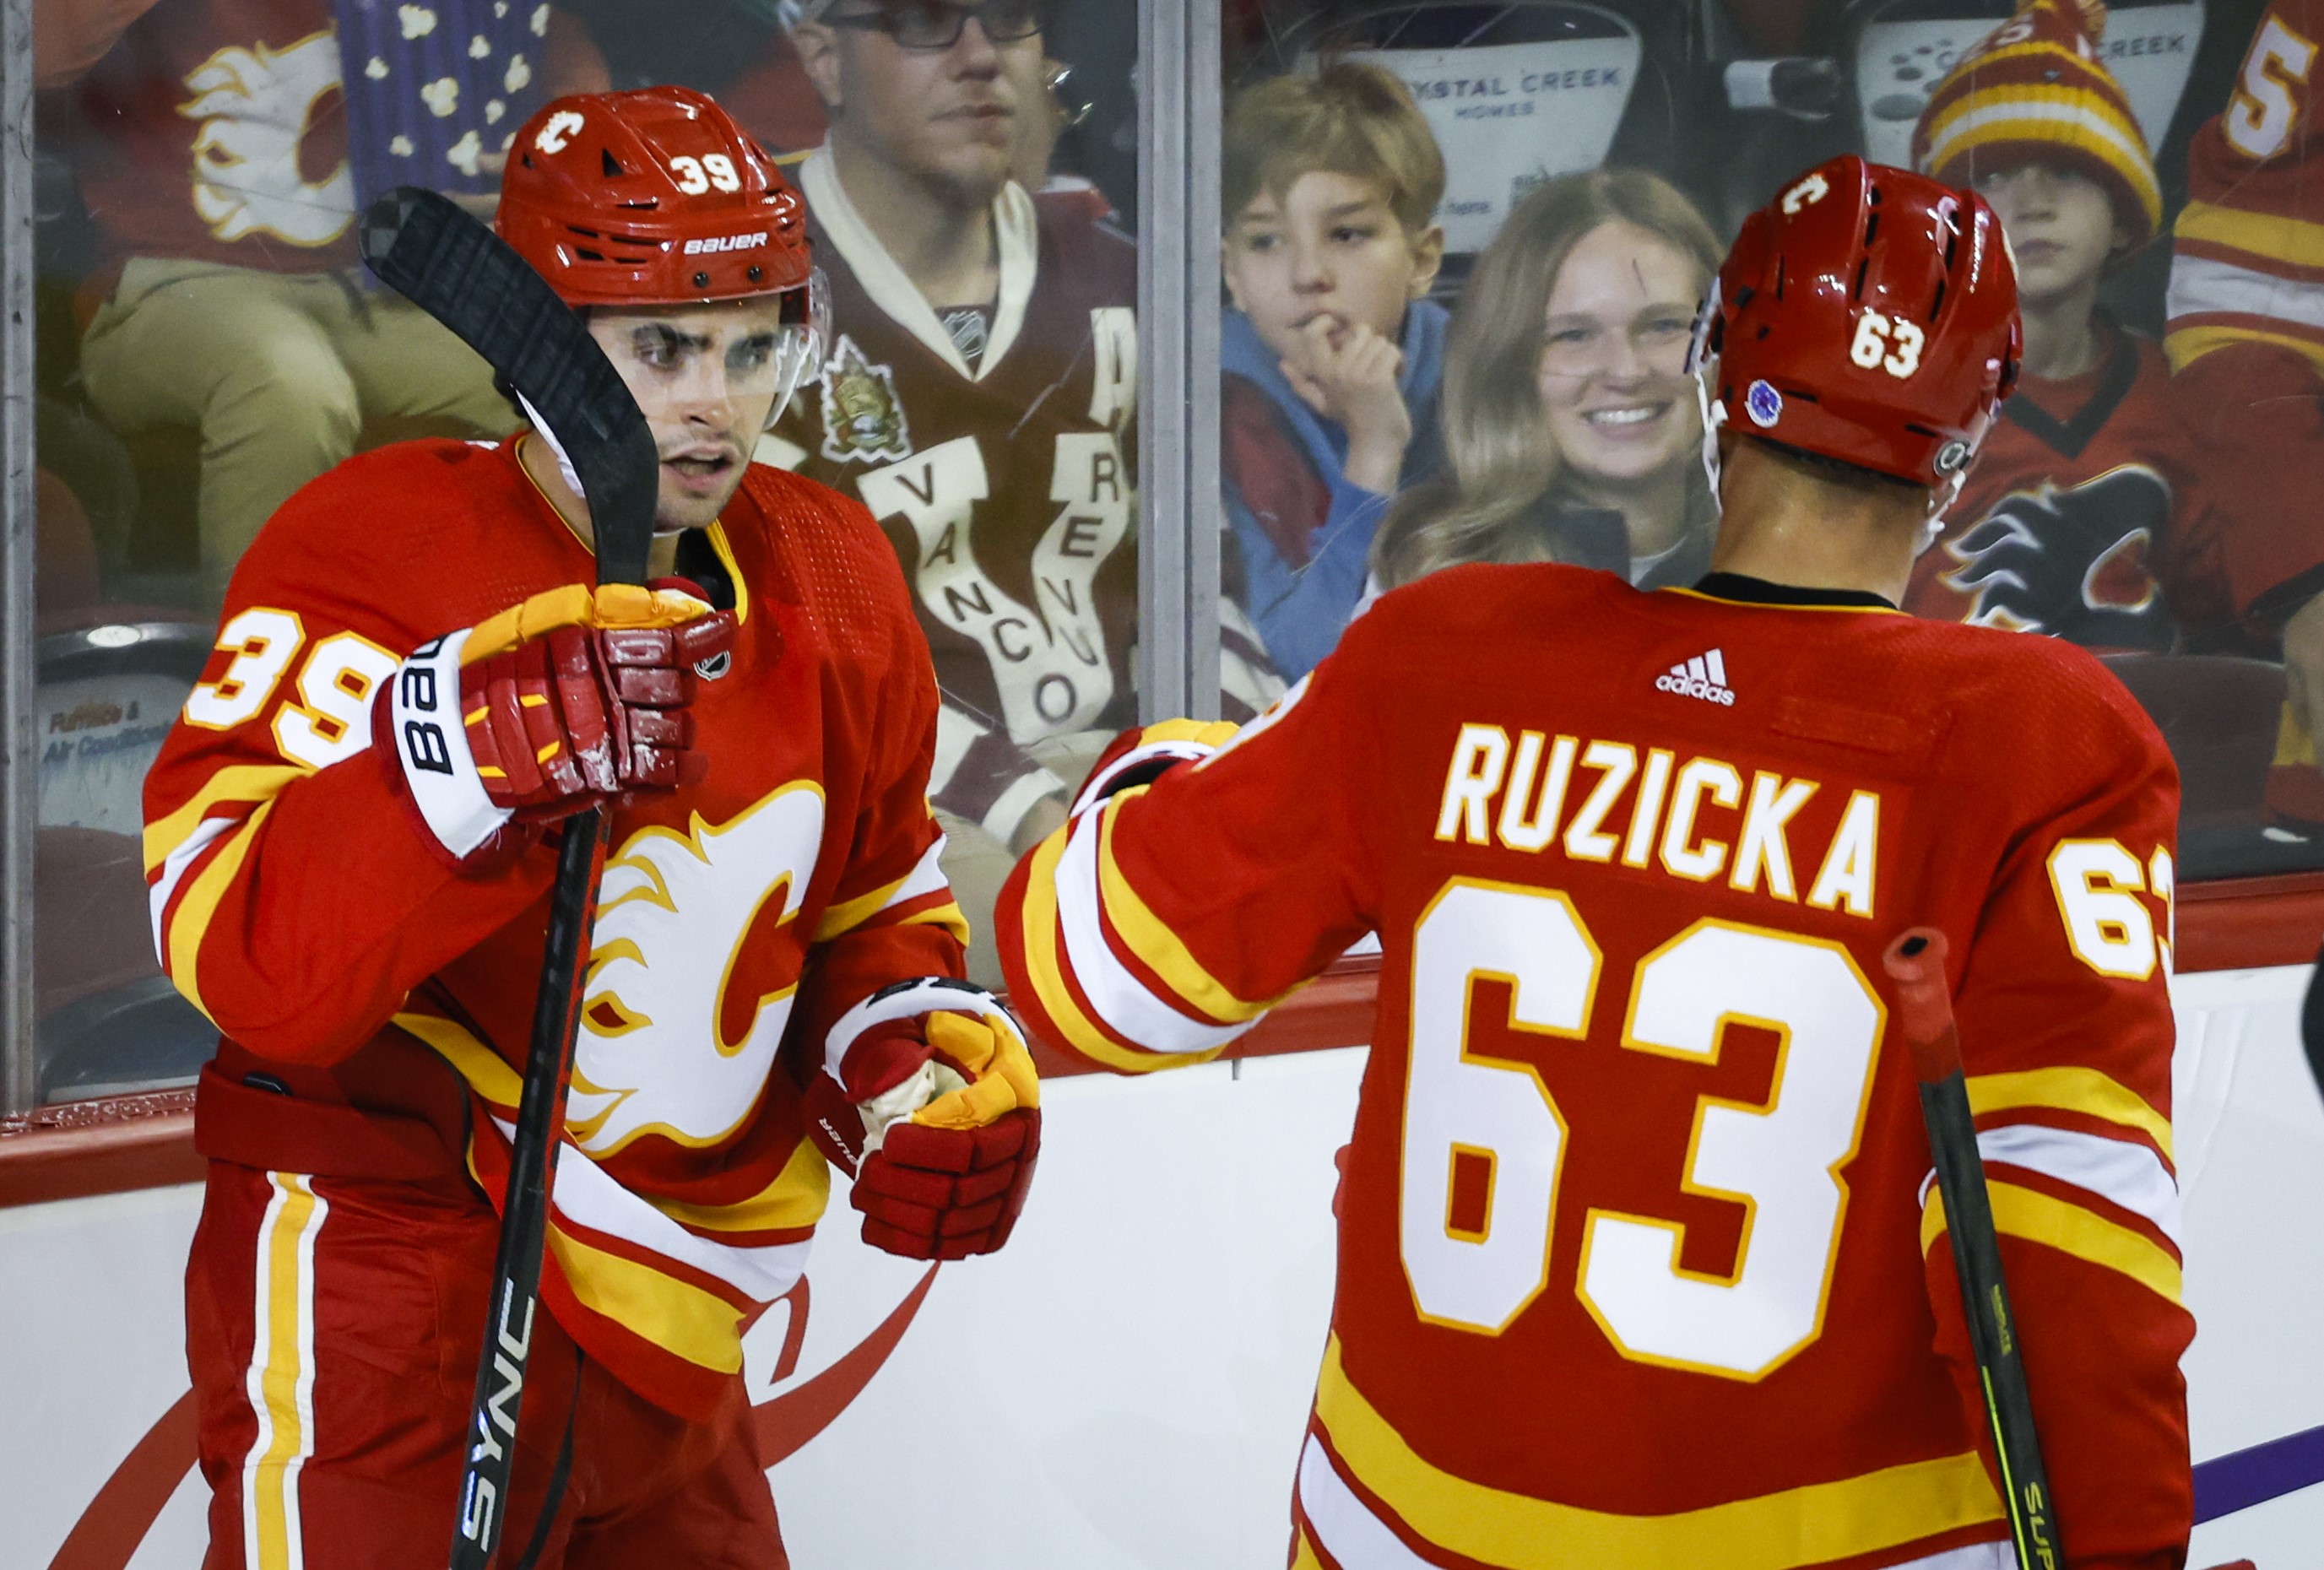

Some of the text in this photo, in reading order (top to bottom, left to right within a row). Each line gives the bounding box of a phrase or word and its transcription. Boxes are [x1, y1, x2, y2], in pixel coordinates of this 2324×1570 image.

[1521, 67, 1620, 95] CREEK
[669, 153, 743, 196] 39
[683, 231, 768, 255] BAUER
[1850, 311, 1926, 379] 63
[181, 605, 405, 772] 39
[1655, 672, 1735, 706] adidas
[1434, 722, 1880, 918] RUZICKA
[1399, 874, 1888, 1383] 63
[461, 1276, 535, 1553] SYNC
